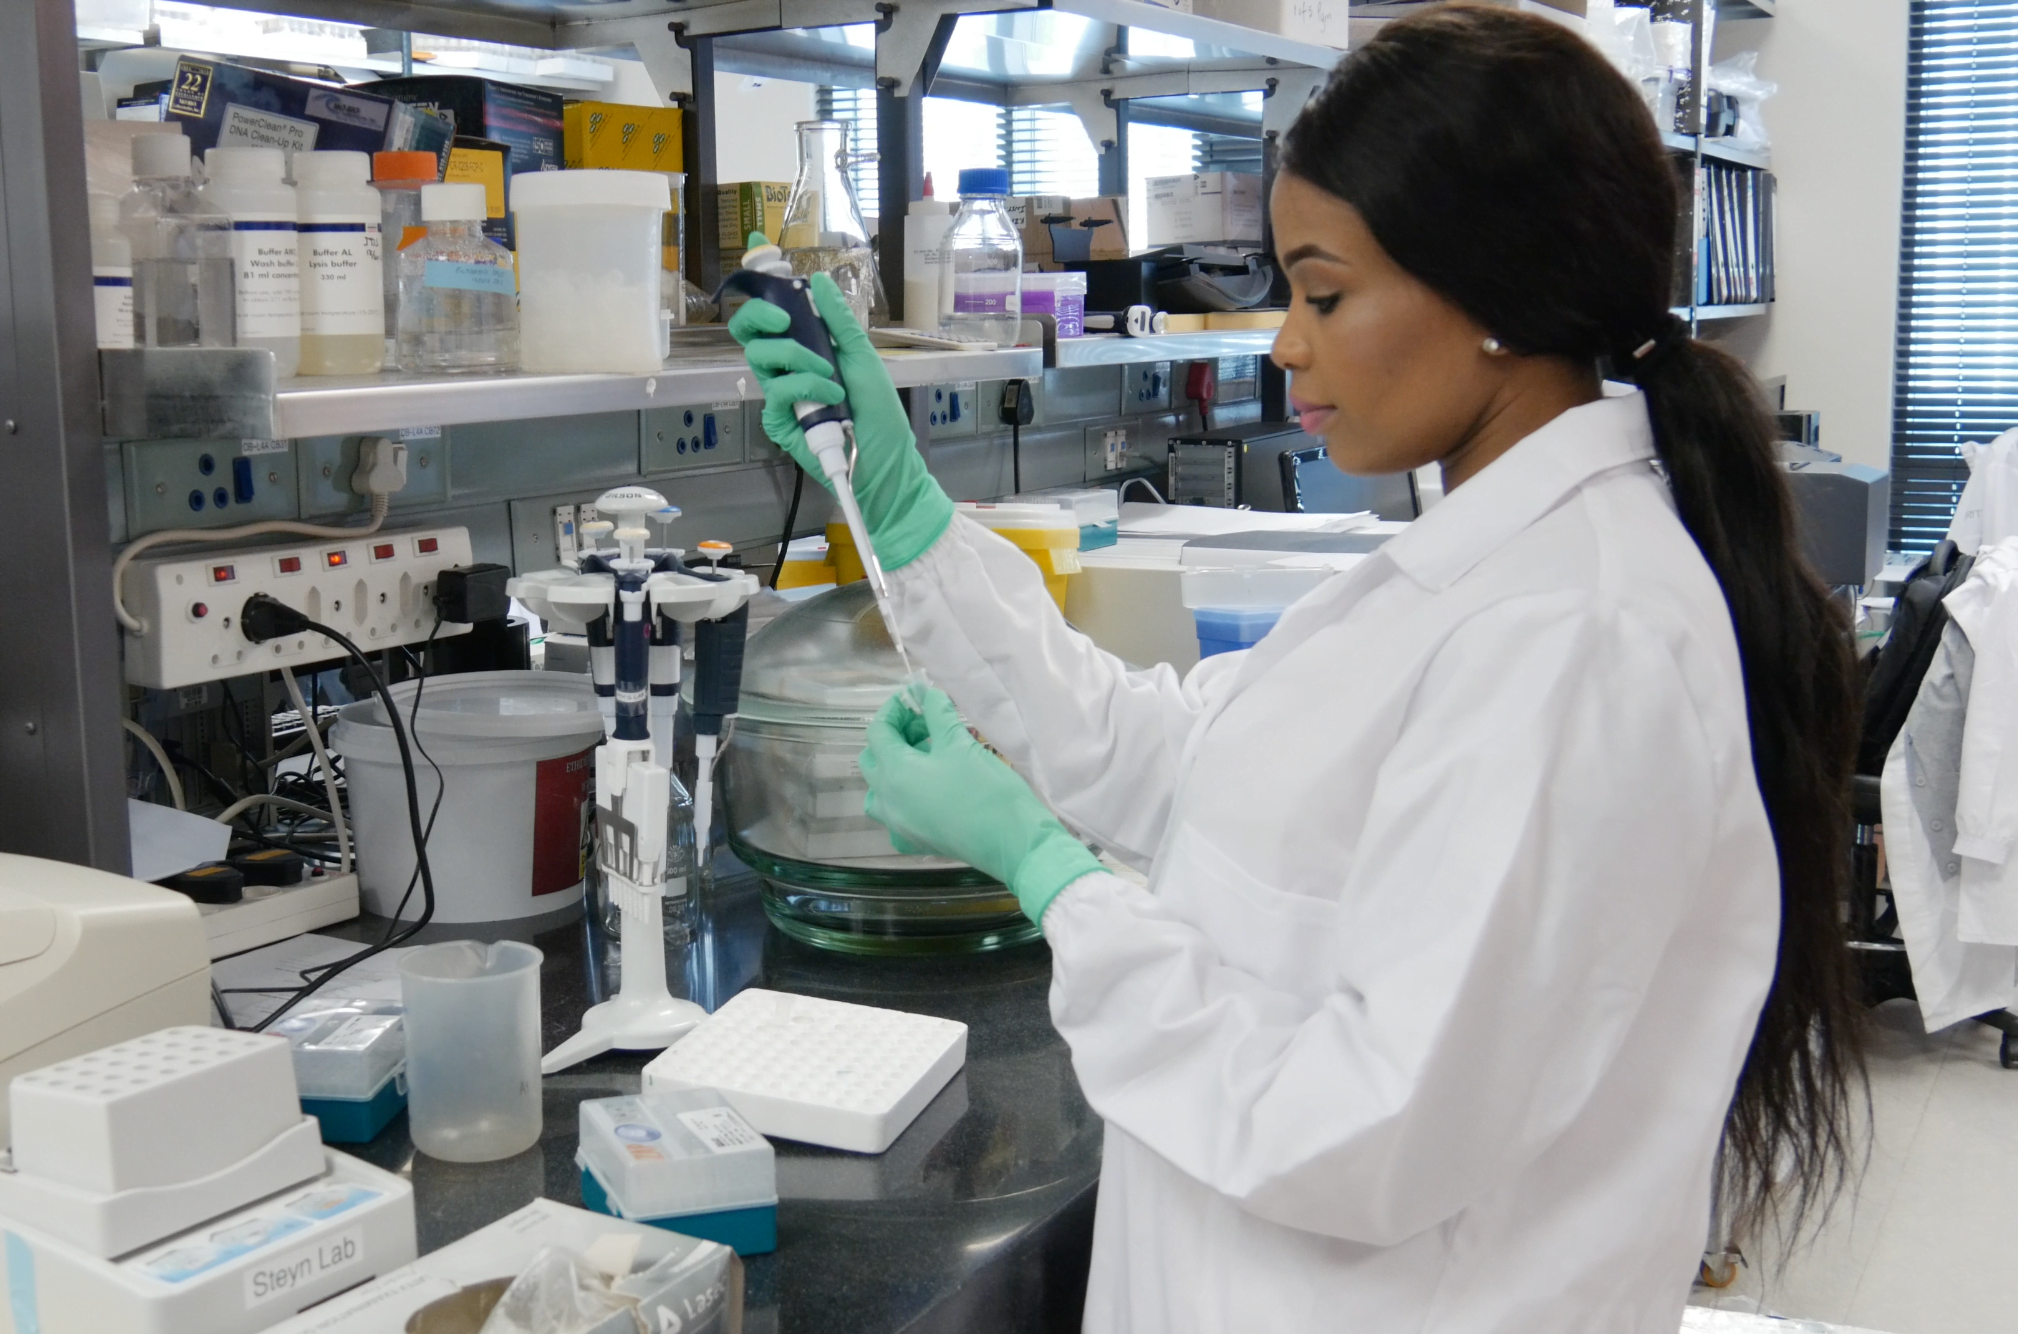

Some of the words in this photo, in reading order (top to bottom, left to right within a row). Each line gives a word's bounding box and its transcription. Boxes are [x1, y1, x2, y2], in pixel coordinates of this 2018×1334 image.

[181, 73, 202, 92] 22
[229, 124, 248, 138] DNA
[251, 130, 290, 148] Clean-Up
[292, 139, 304, 150] Kit
[289, 126, 304, 138] Pro
[742, 199, 751, 230] SMALL
[755, 197, 763, 227] SMALL
[257, 248, 282, 256] Buffer
[312, 248, 339, 256] Buffer
[308, 260, 328, 270] Lysis
[330, 259, 357, 267] buffer
[243, 271, 255, 279] 81
[258, 271, 270, 279] ml
[985, 298, 997, 306] 200
[252, 1257, 312, 1298] Steyn
[318, 1237, 356, 1270] Lab
